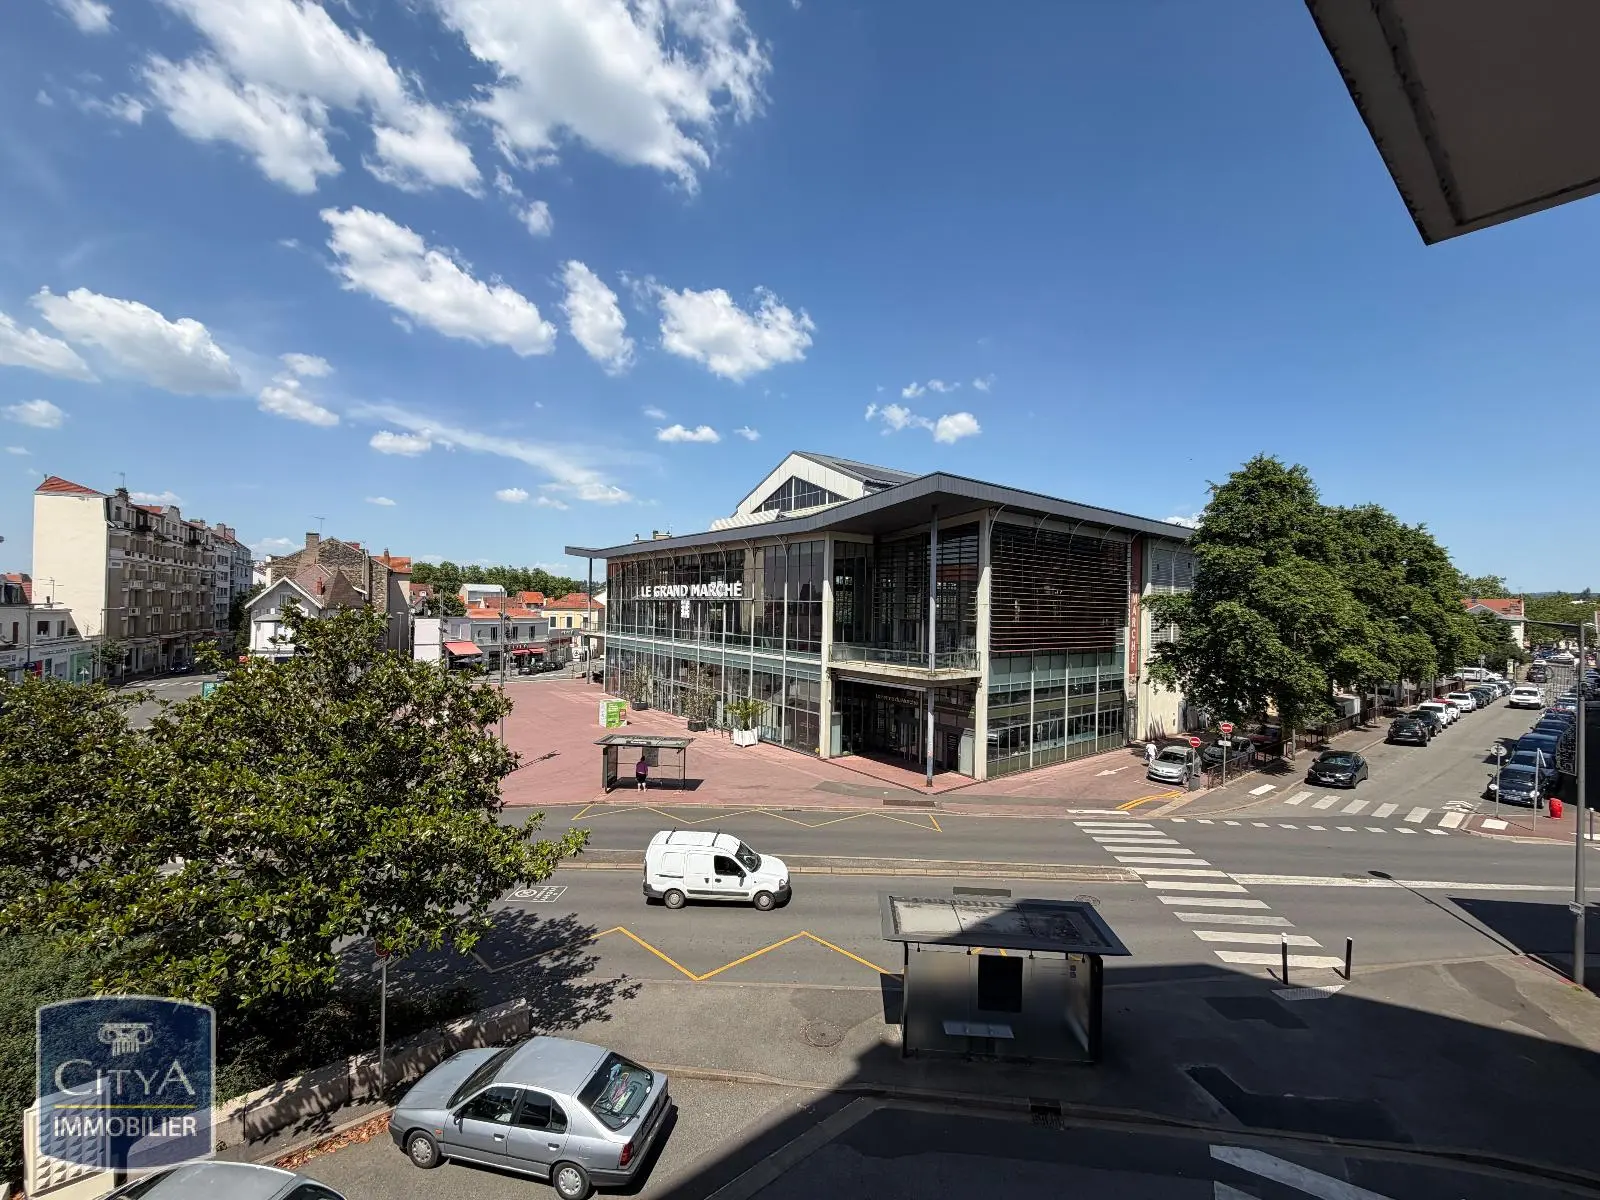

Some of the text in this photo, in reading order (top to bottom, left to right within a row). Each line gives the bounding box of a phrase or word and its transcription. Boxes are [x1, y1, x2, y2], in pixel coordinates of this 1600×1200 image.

[641, 580, 743, 598] LE GRAND MARCHÉ
